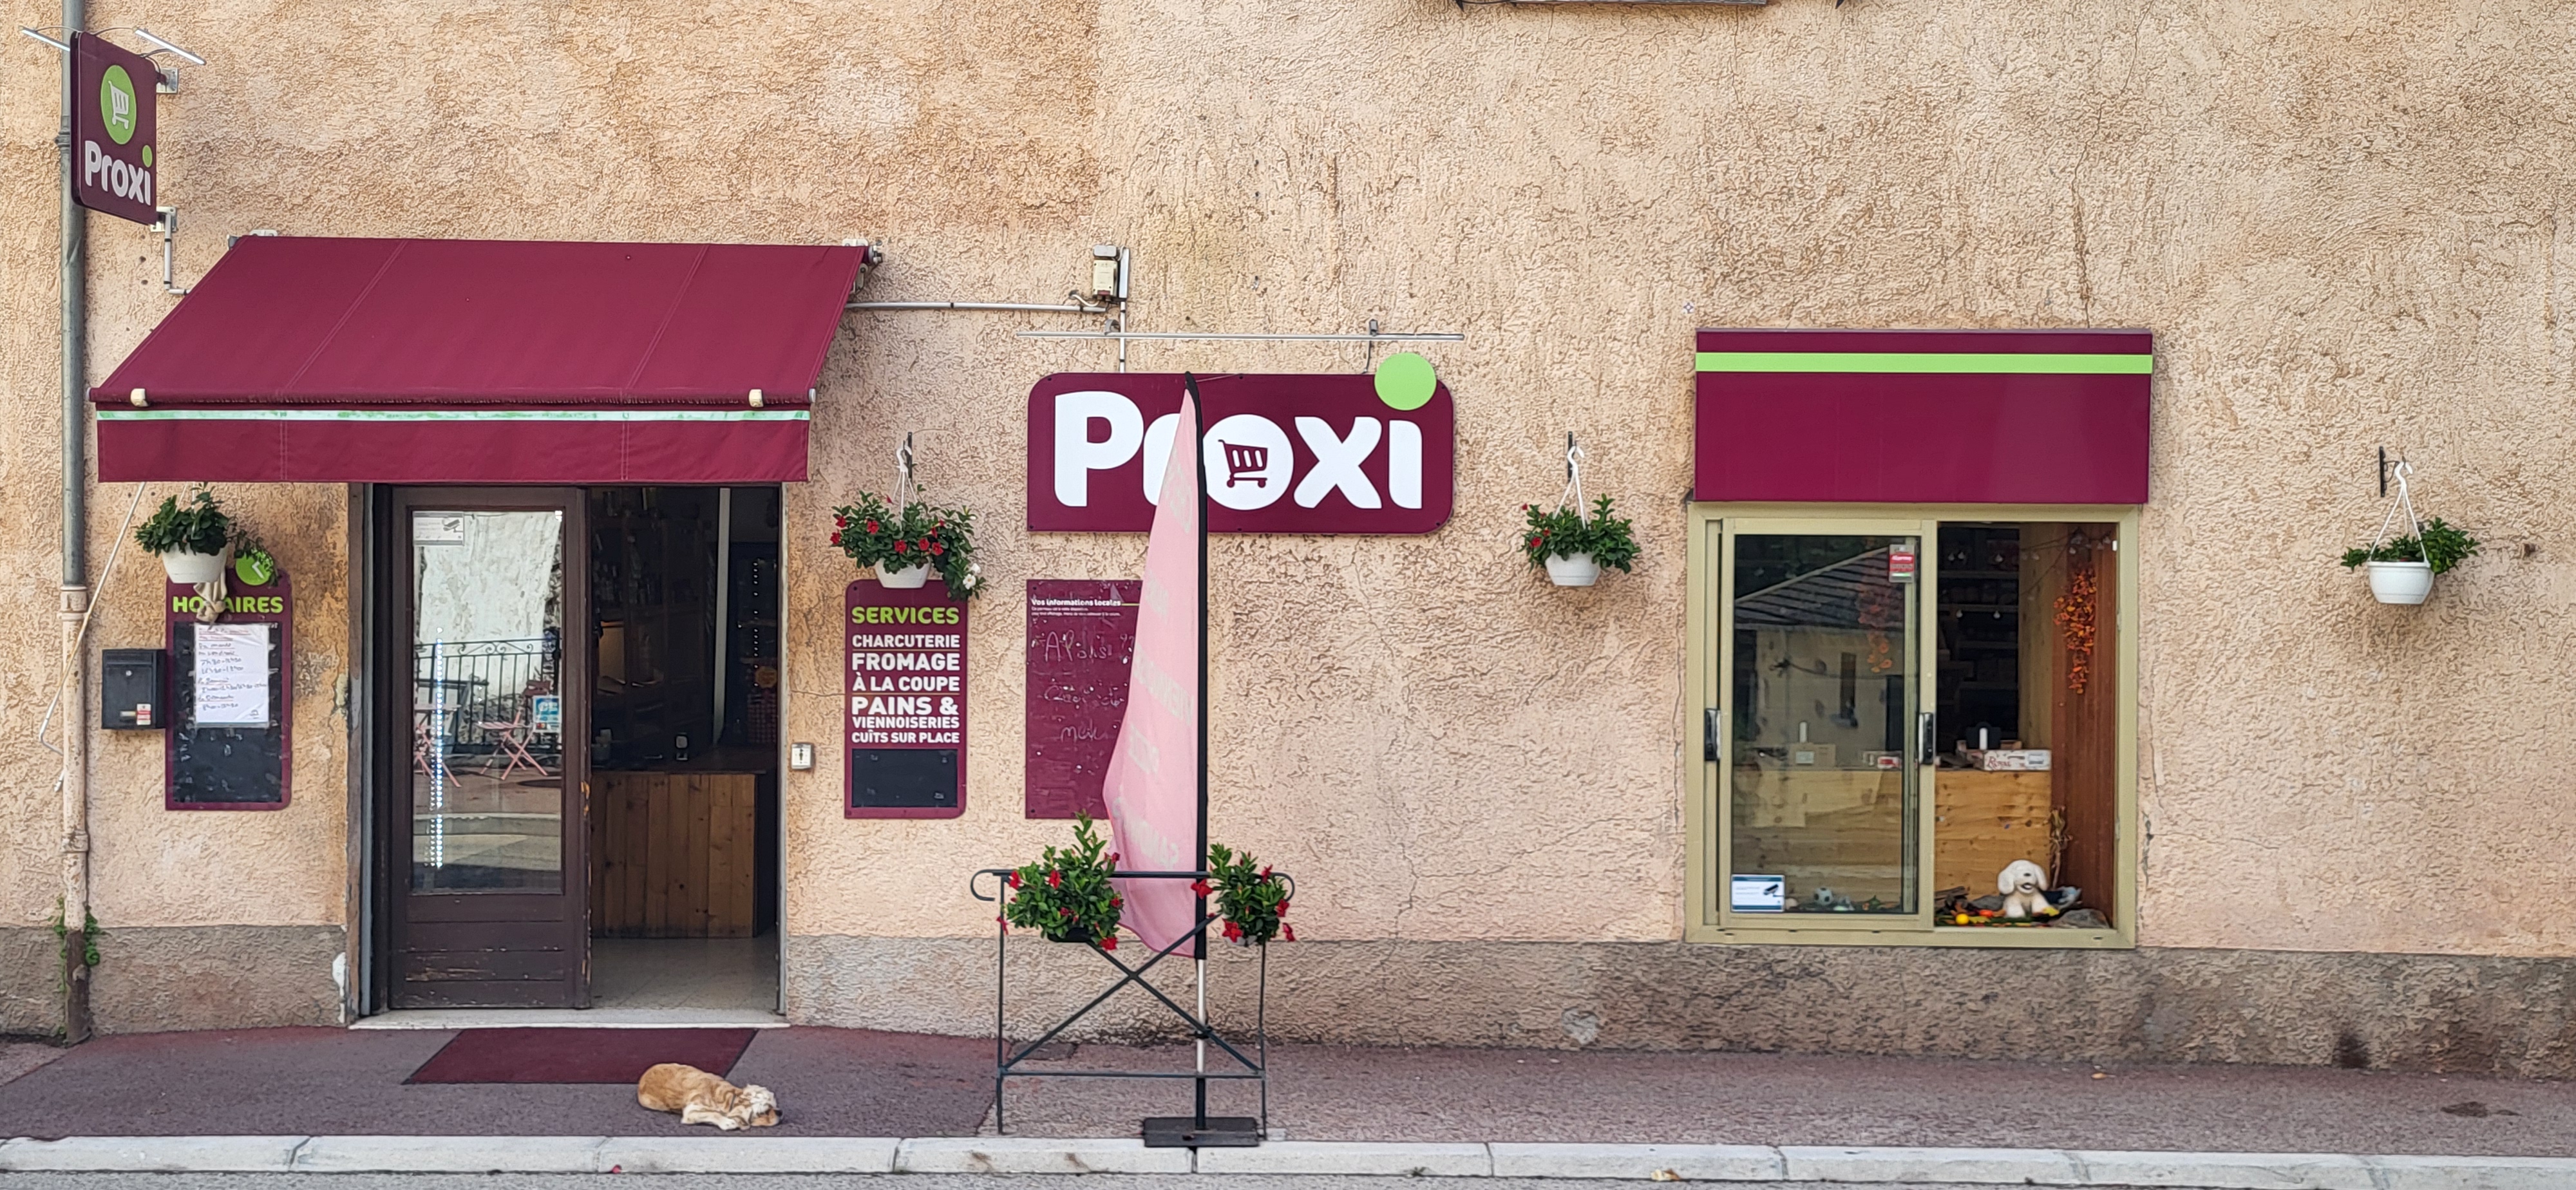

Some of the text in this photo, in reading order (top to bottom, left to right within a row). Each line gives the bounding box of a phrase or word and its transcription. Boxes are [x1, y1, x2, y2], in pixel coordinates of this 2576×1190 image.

[84, 140, 153, 206] Proxi
[173, 596, 283, 614] HOAIRES
[851, 607, 960, 624] SERVICES
[852, 634, 960, 648] CHARCUTERIE
[852, 653, 960, 671] FROMAGE
[852, 672, 960, 692] À LA COUPE
[851, 697, 959, 715] PAINS &
[852, 717, 960, 729] VIENNOISERIES
[891, 732, 916, 743] SUR
[919, 732, 960, 743] PLACE
